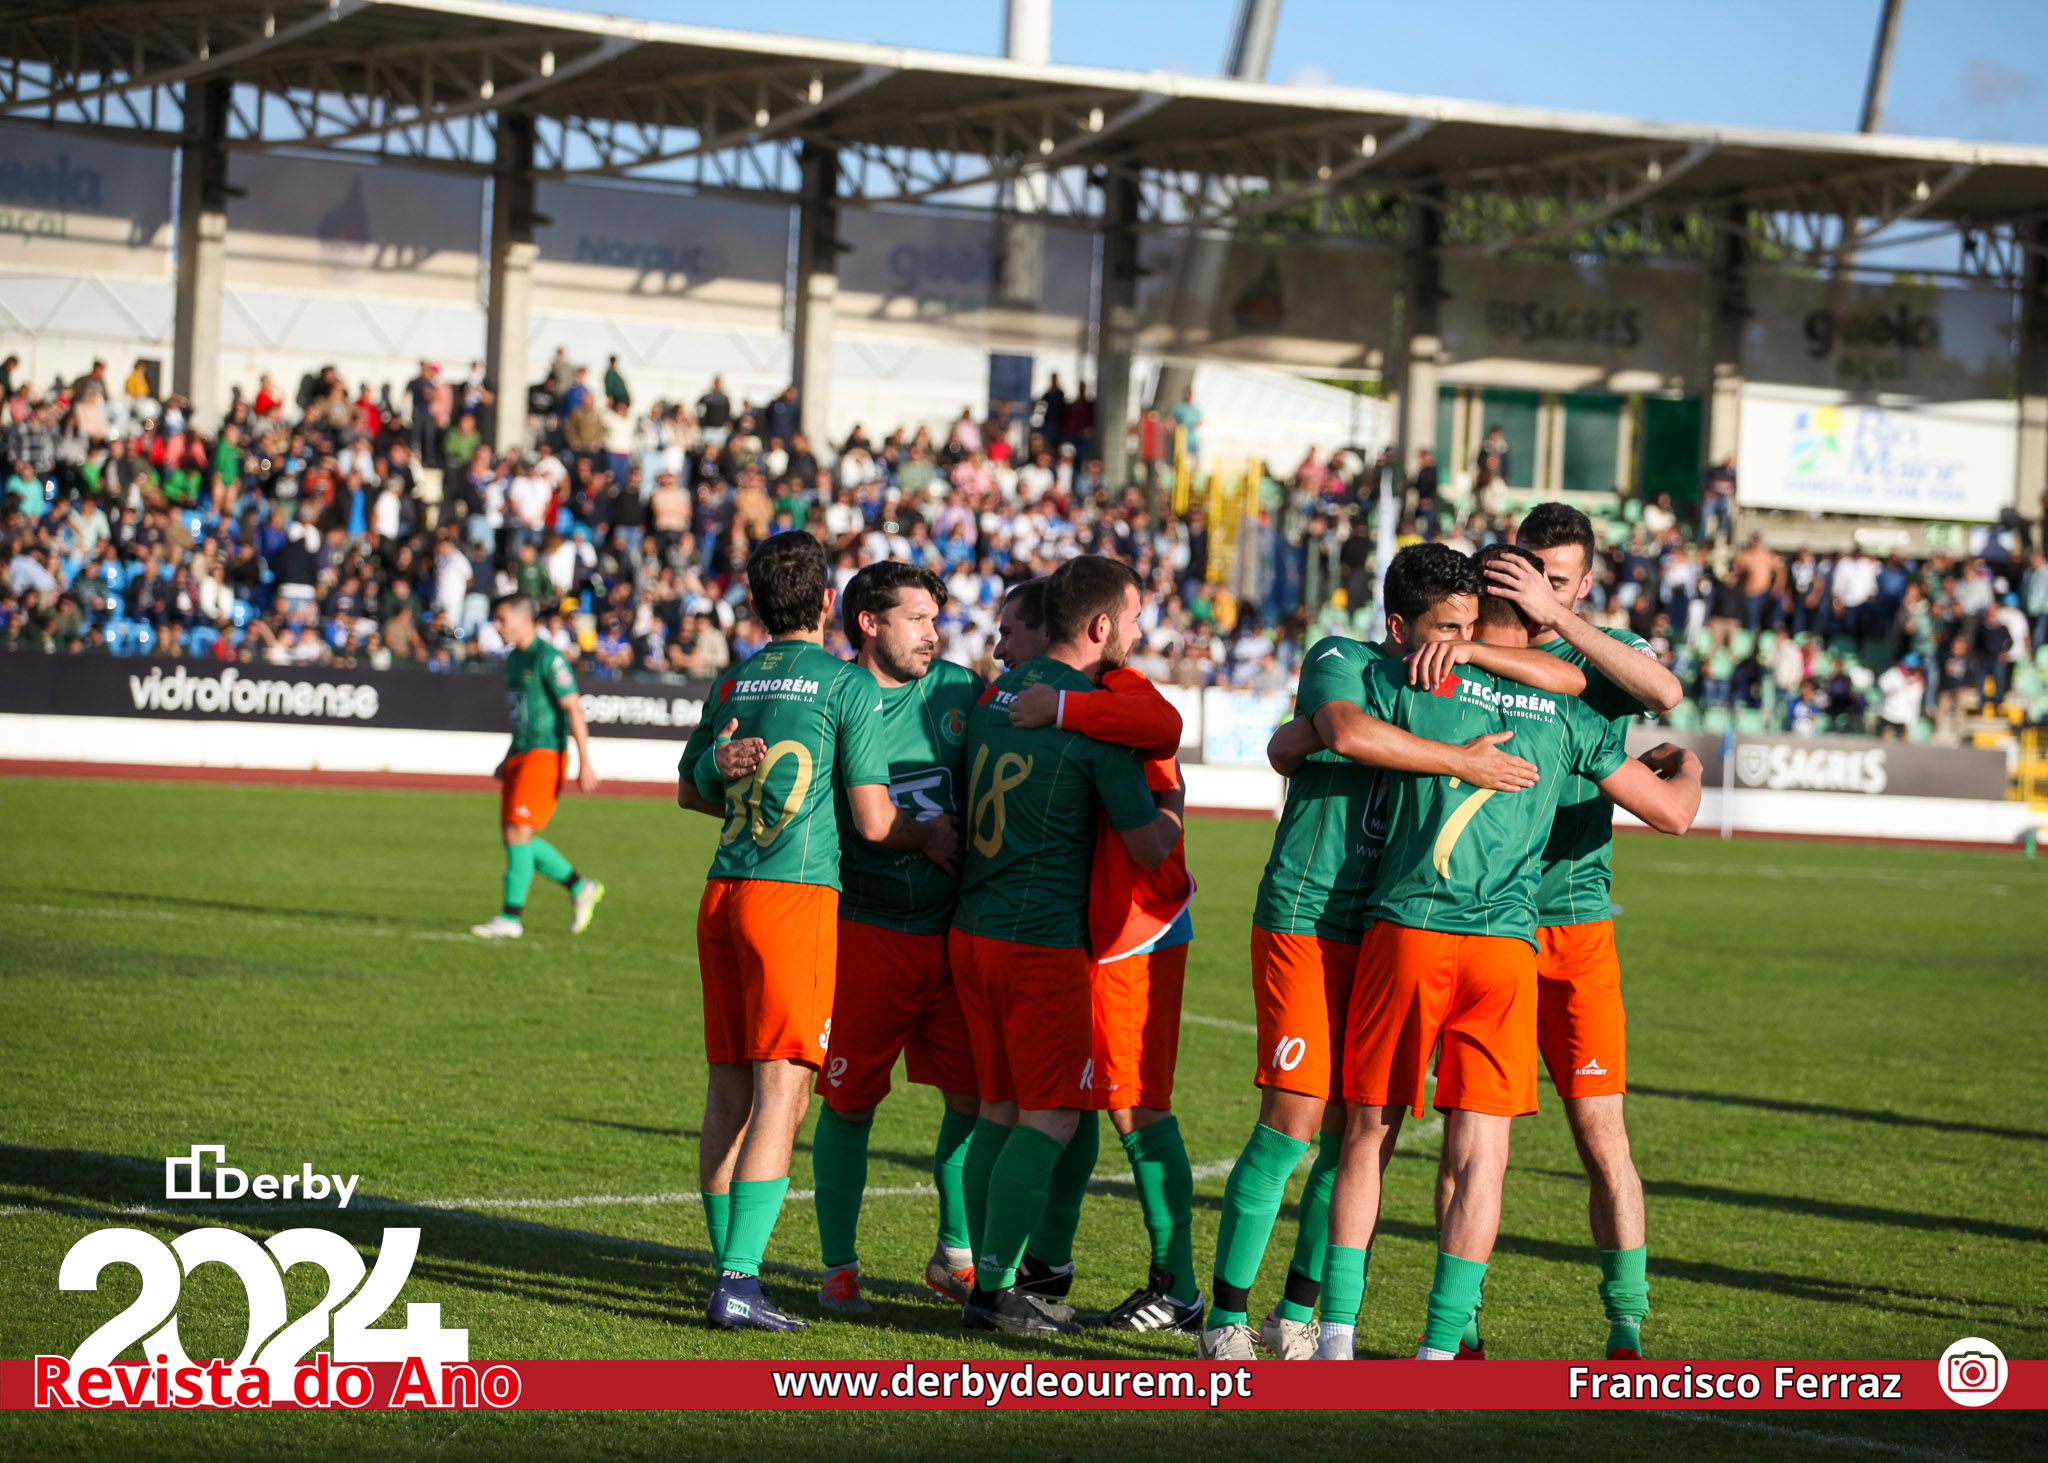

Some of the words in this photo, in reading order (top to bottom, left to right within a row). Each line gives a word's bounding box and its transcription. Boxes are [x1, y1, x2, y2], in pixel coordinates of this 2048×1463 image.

[129, 664, 380, 720] vidrofornense
[735, 676, 819, 695] TECNORÉM
[1461, 678, 1556, 716] TECNORÉM
[577, 693, 671, 727] OSPITAL
[1767, 744, 1888, 794] SAGRES
[966, 743, 1034, 859] 18
[1272, 1035, 1306, 1071] 10
